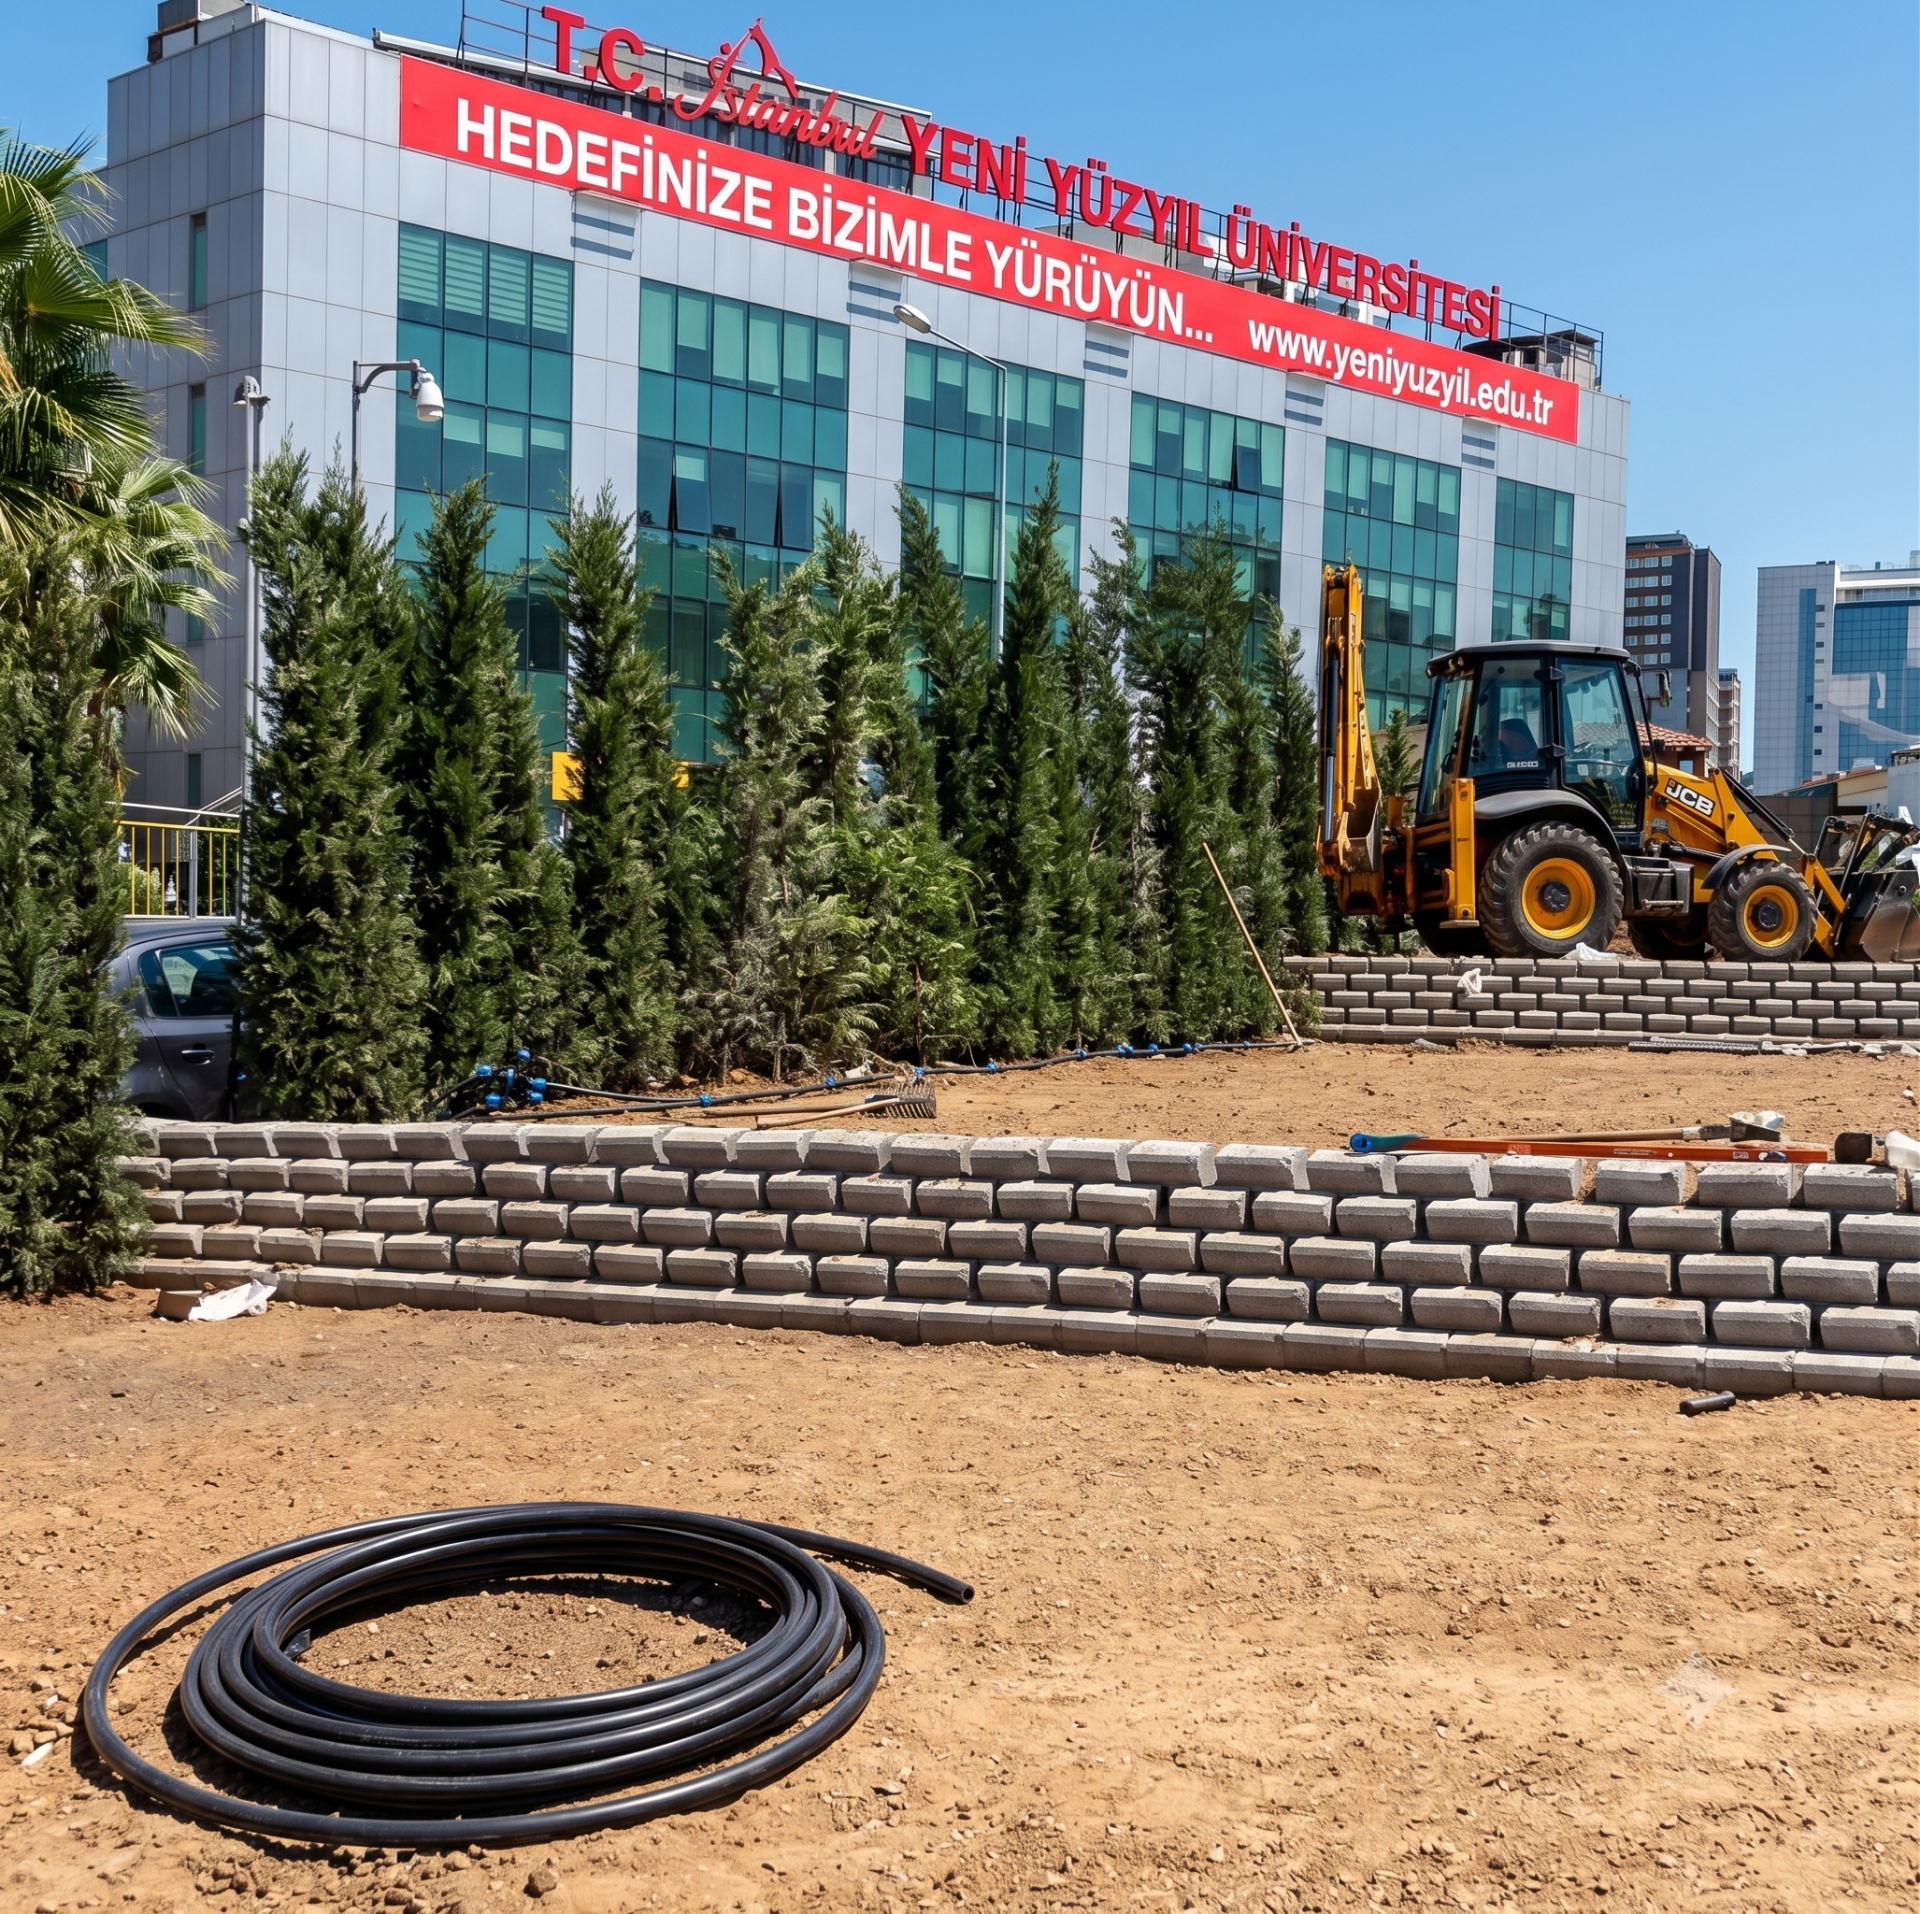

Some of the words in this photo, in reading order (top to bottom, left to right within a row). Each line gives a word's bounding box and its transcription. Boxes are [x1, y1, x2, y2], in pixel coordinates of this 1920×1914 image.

[457, 97, 774, 230] HEDEFİNİZE
[787, 182, 973, 282] BİZİMLE
[984, 238, 1214, 344] YÜRÜYÜN...
[1247, 319, 1554, 427] www.yeniyuzyil.edu.tr
[541, 5, 663, 101] T.C.
[673, 16, 886, 159] İstanbul
[900, 113, 1026, 204] YENİ
[1044, 157, 1215, 258] YÜZYIL
[1226, 204, 1501, 342] ÜNİVERSİTESİ
[1665, 784, 1714, 816] JCB
